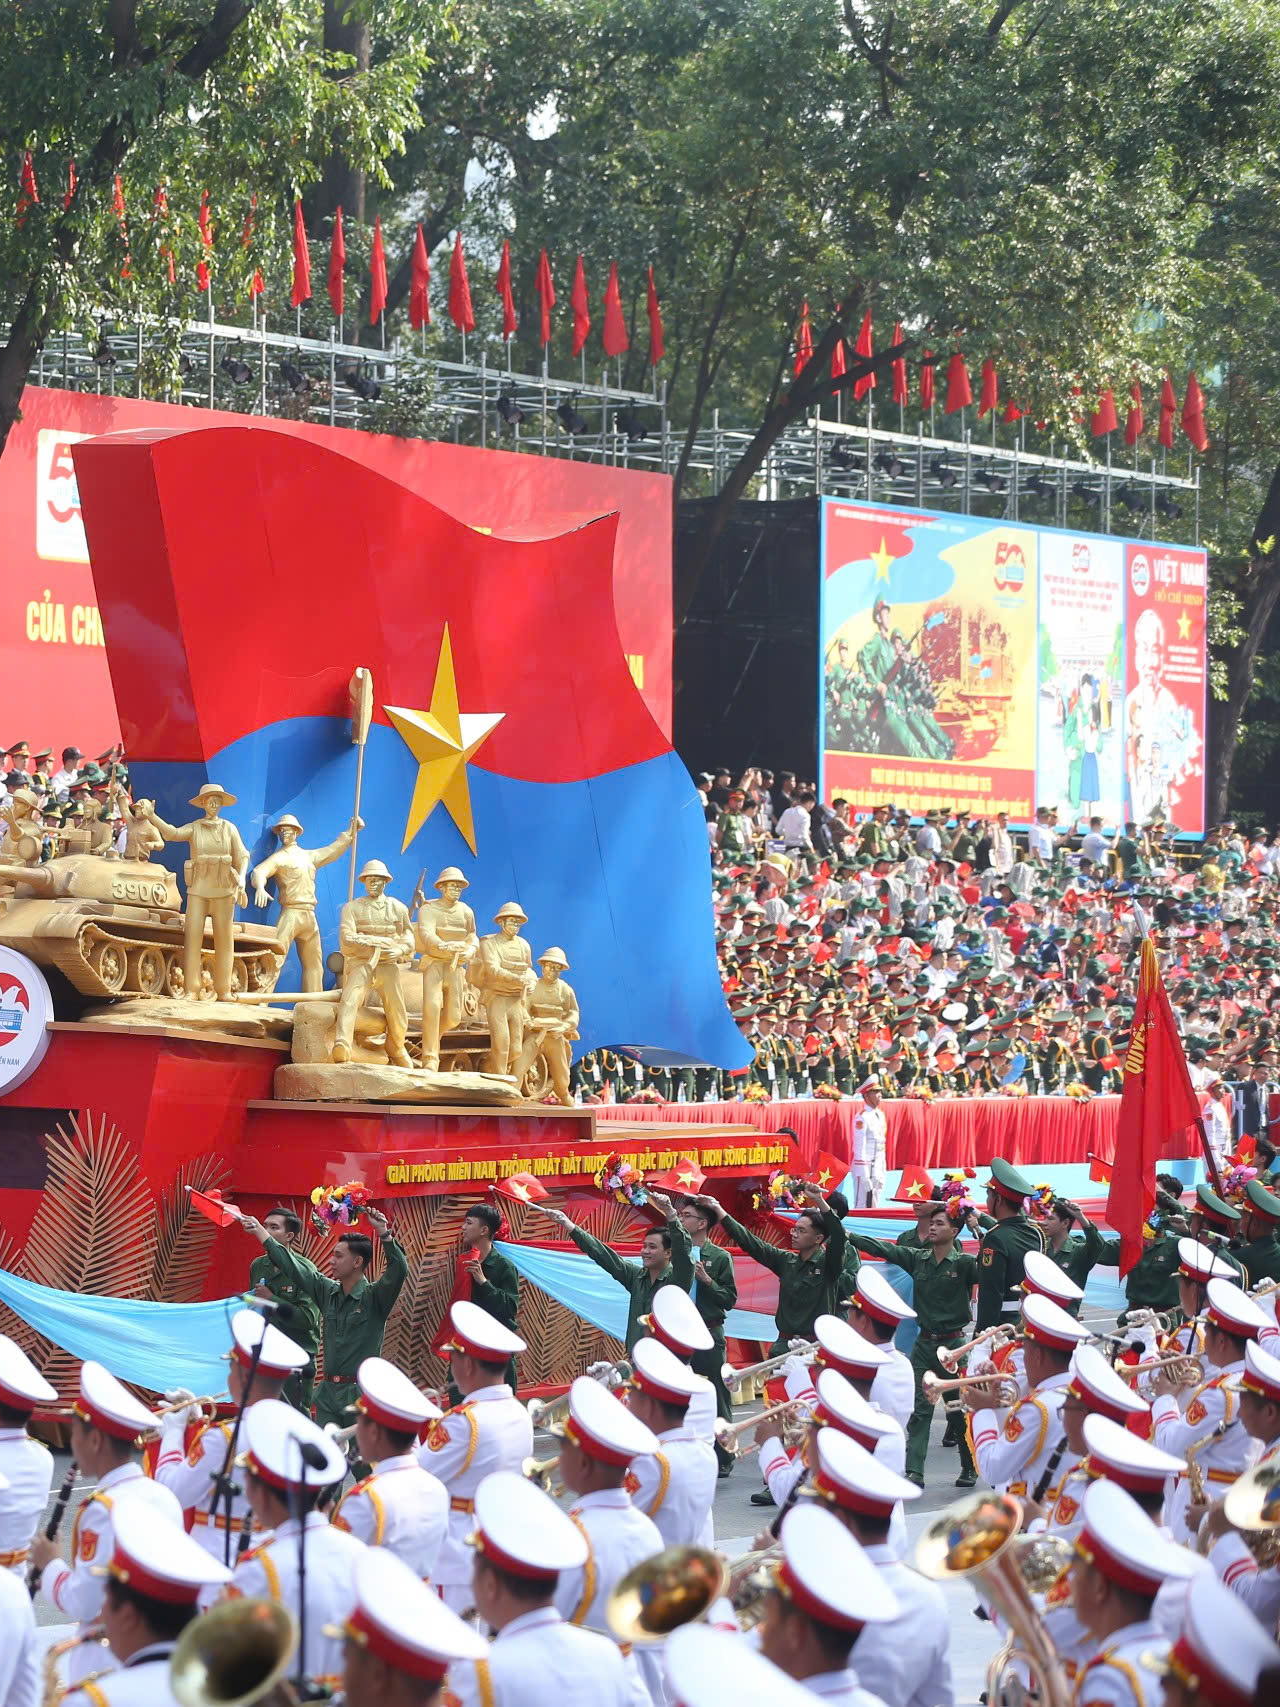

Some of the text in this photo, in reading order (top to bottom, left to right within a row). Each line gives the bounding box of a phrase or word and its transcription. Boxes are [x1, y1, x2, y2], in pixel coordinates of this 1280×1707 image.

[26, 589, 106, 647] CỦA CH
[112, 880, 151, 902] 390
[7, 1057, 20, 1066] NAM
[387, 1158, 409, 1184] GIẢI
[411, 1160, 446, 1182] PHÓNG
[534, 1151, 560, 1176] NHẤT
[583, 1152, 608, 1173] NƯỚ
[702, 1149, 722, 1167] NON
